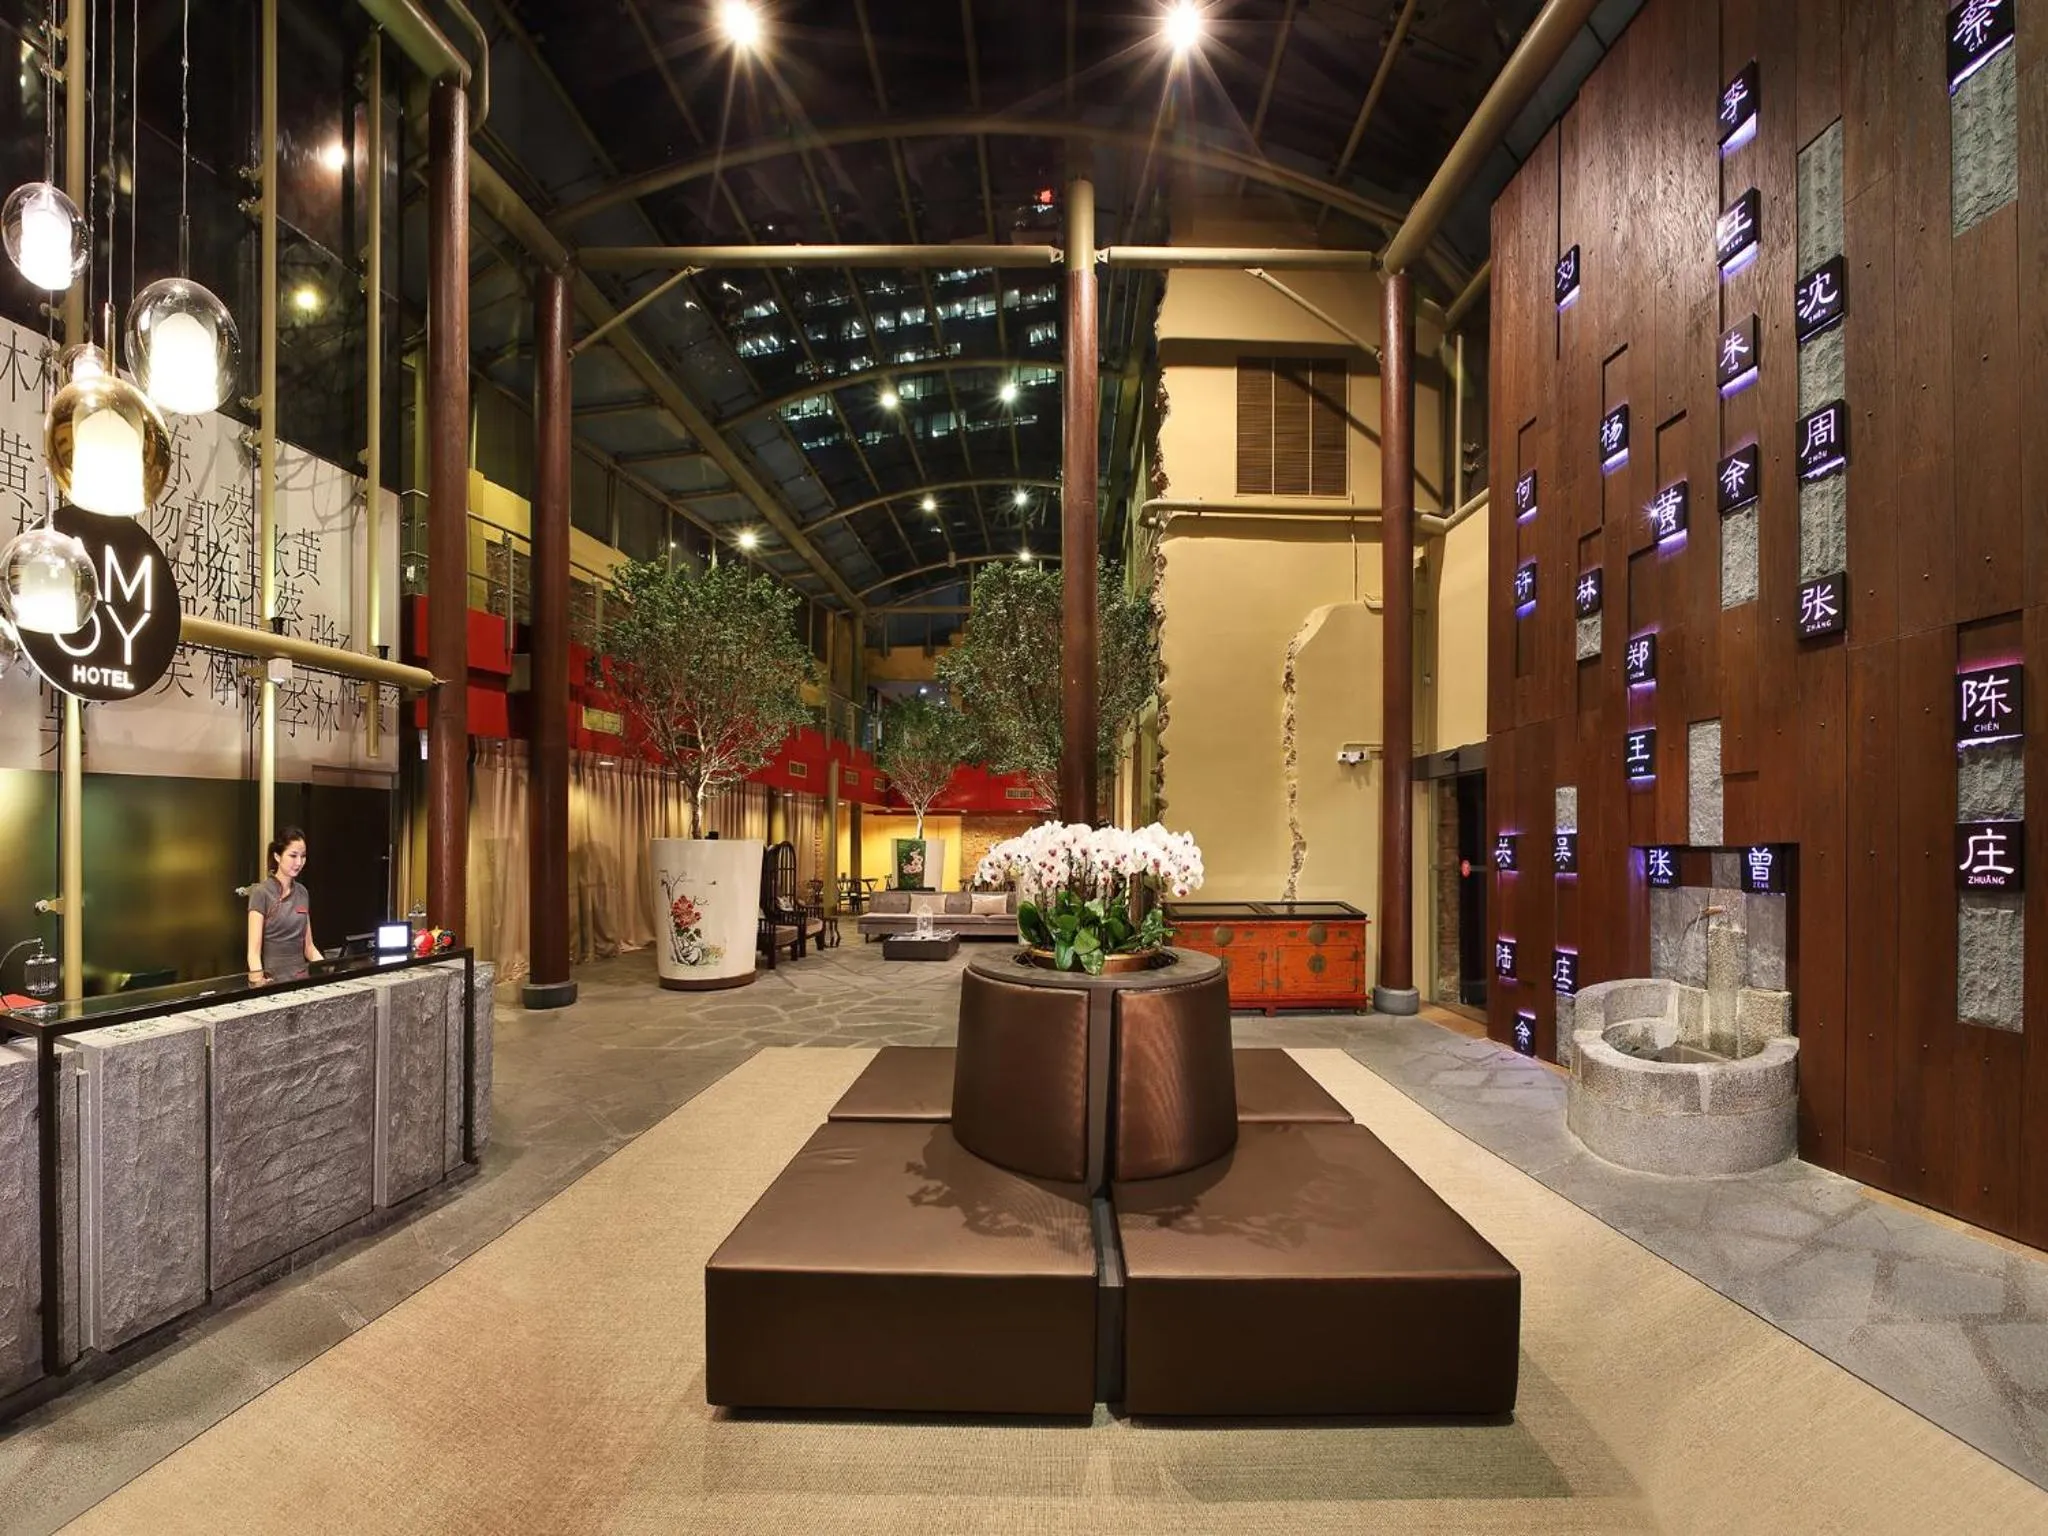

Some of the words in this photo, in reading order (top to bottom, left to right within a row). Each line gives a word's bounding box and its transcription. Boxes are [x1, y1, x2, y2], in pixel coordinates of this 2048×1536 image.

[1720, 79, 1749, 121] 李
[1556, 251, 1575, 289] 刘
[1797, 272, 1838, 319] 沈
[1720, 331, 1748, 368] 朱
[1800, 409, 1836, 459] 周
[1720, 458, 1749, 493] 余
[1656, 488, 1682, 530] 黄
[293, 527, 322, 586] 黄
[1576, 576, 1597, 604] 林
[1801, 583, 1839, 624] 张
[1626, 641, 1649, 669] 郑
[72, 663, 135, 690] HOTEL
[1962, 674, 2012, 721] 陈
[1627, 735, 1650, 762] 王
[1553, 837, 1571, 862] 吴
[1648, 849, 1673, 876] 张
[1748, 846, 1773, 880] 曾
[1959, 827, 2015, 873] 庄
[1553, 956, 1572, 984] 庄
